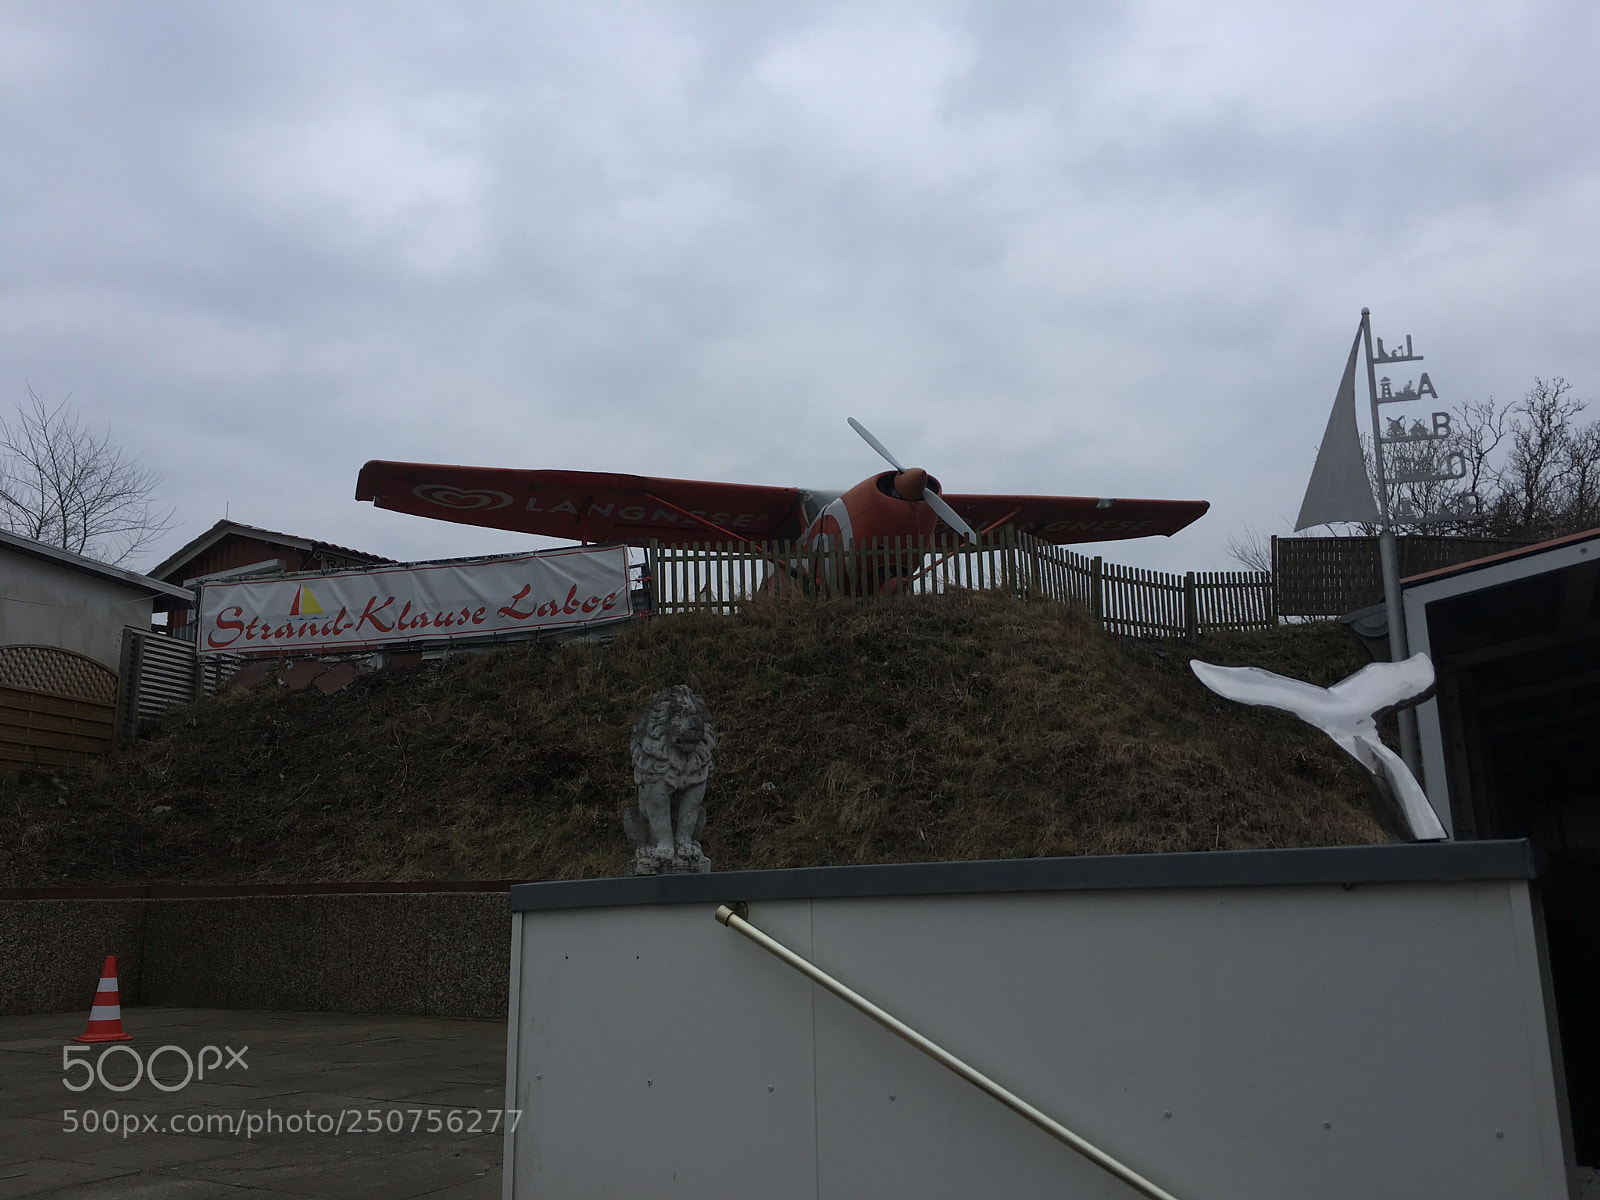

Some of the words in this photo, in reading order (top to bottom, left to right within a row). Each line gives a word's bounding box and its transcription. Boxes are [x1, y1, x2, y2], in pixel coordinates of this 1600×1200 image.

[525, 497, 757, 527] LANGNESE
[207, 595, 489, 648] Strand-Klause
[496, 582, 618, 620] Laboe
